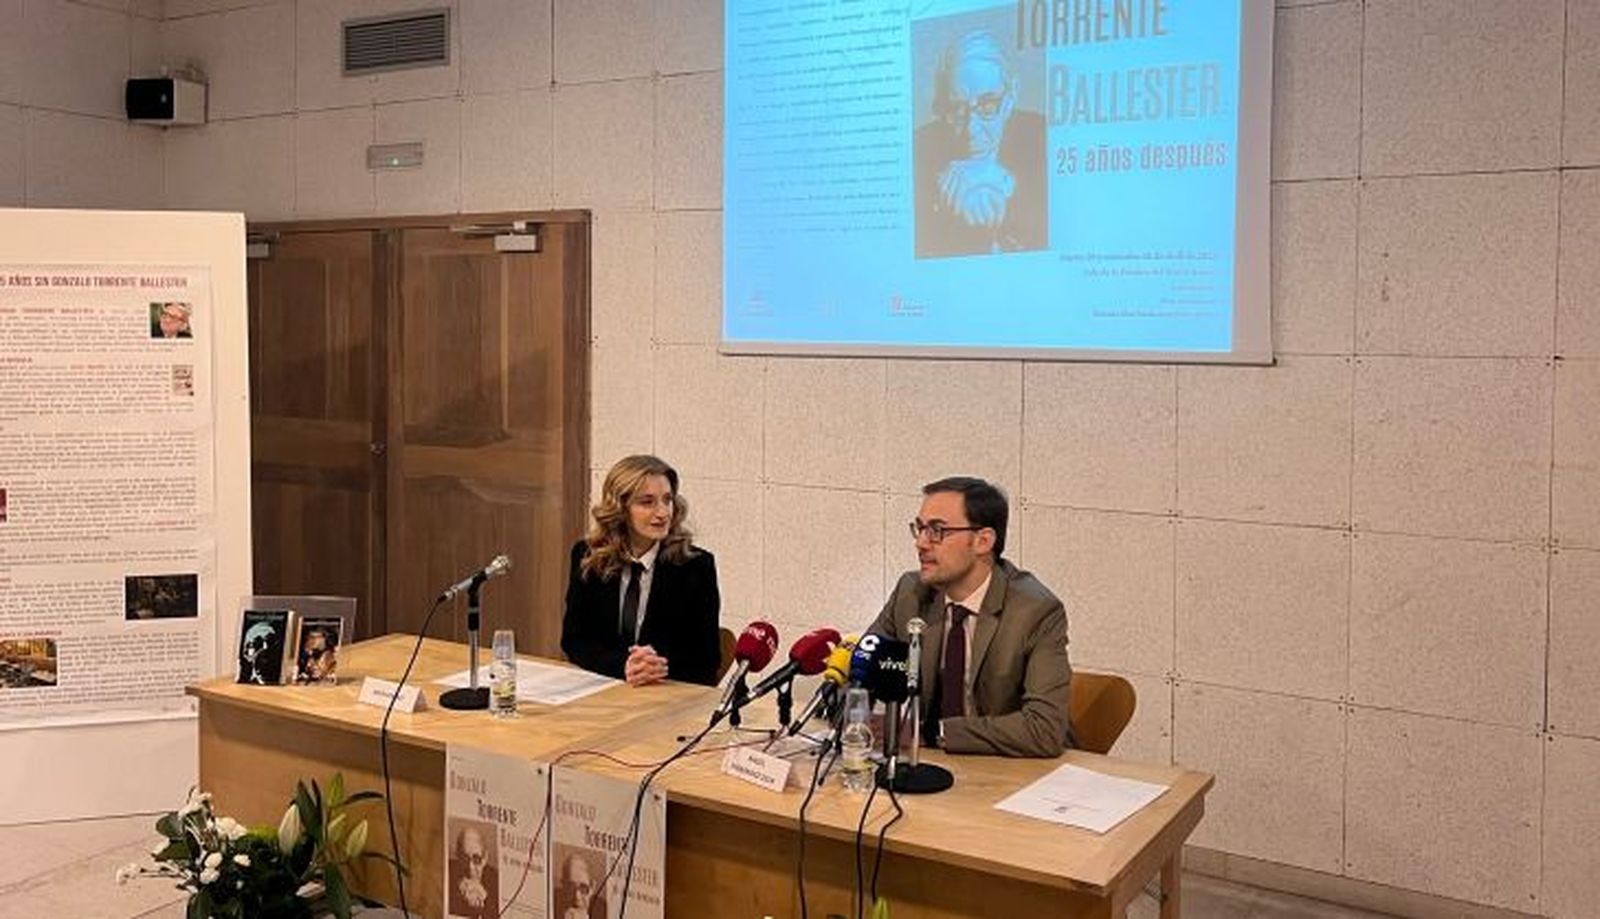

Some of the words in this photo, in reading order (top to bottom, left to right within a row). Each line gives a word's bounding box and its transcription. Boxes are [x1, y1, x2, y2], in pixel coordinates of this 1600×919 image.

[1015, 0, 1169, 50] TORRENTE
[1048, 63, 1221, 127] BALLESTER
[1056, 147, 1078, 175] 25
[1086, 143, 1133, 173] años
[1140, 138, 1227, 171] después
[34, 275, 49, 287] SIN
